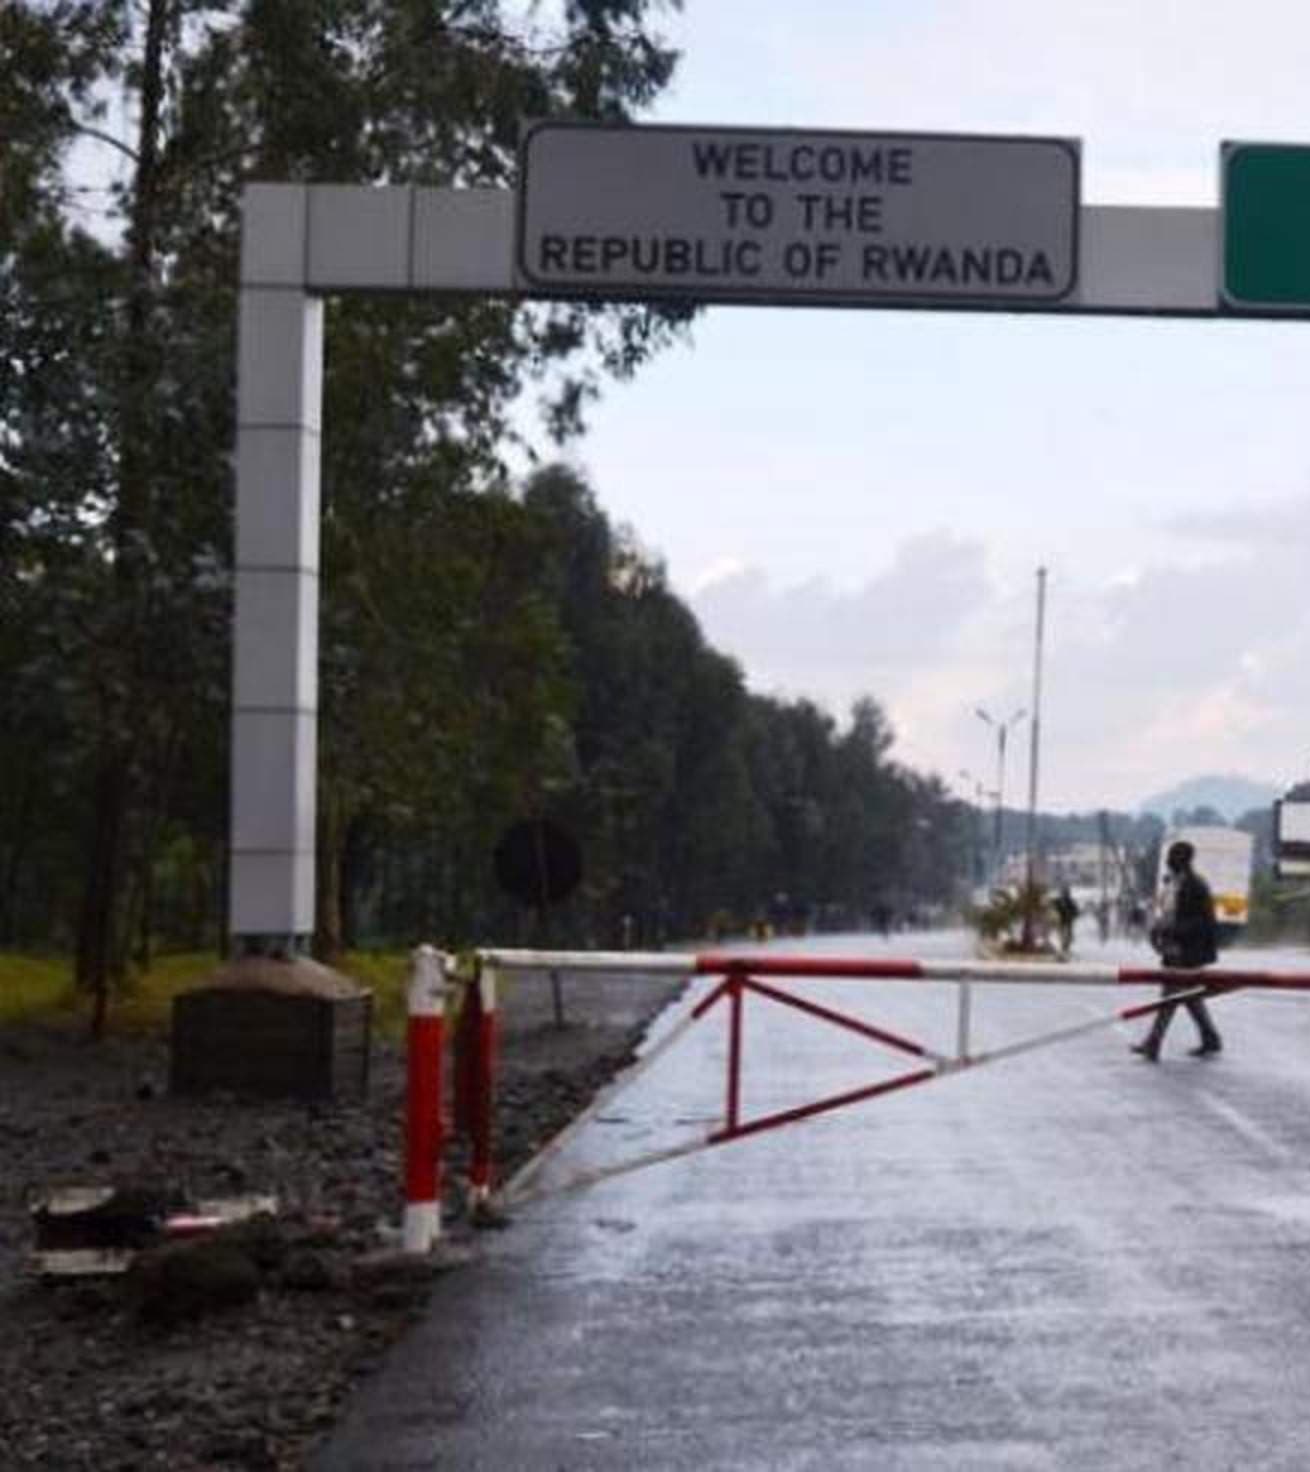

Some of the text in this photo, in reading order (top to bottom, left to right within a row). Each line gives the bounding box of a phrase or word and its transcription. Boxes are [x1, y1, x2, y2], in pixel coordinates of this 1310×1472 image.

[693, 142, 912, 184] WELCOME
[720, 192, 883, 232] TO THE
[540, 235, 1054, 285] REPUBLIC OF RWANDA
